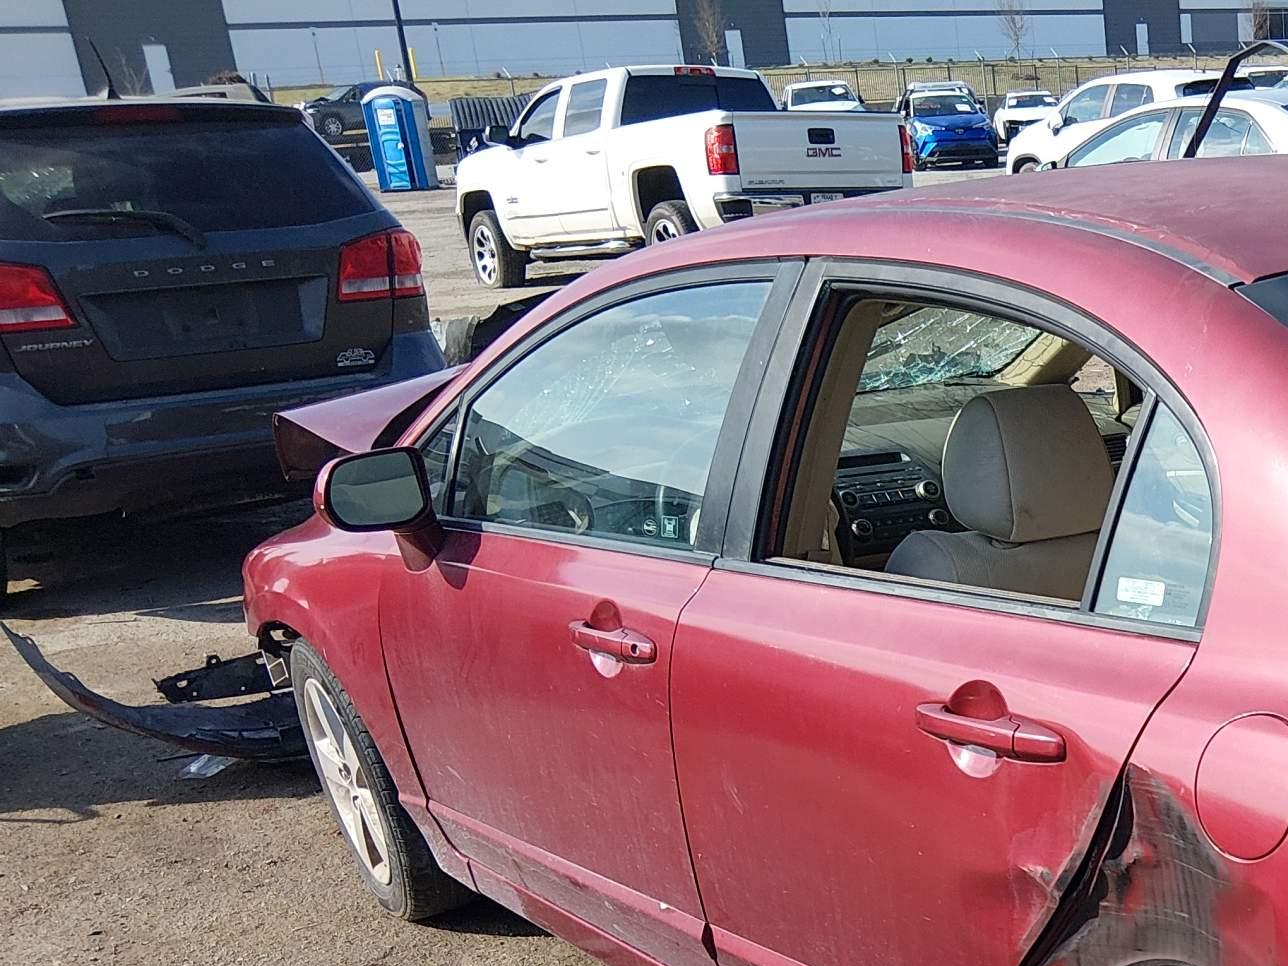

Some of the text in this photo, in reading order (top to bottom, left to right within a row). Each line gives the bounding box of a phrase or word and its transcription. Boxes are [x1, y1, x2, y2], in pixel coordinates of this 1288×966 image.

[806, 147, 842, 158] GMC
[133, 258, 276, 278] DODGE
[15, 338, 95, 353] JOURNEY
